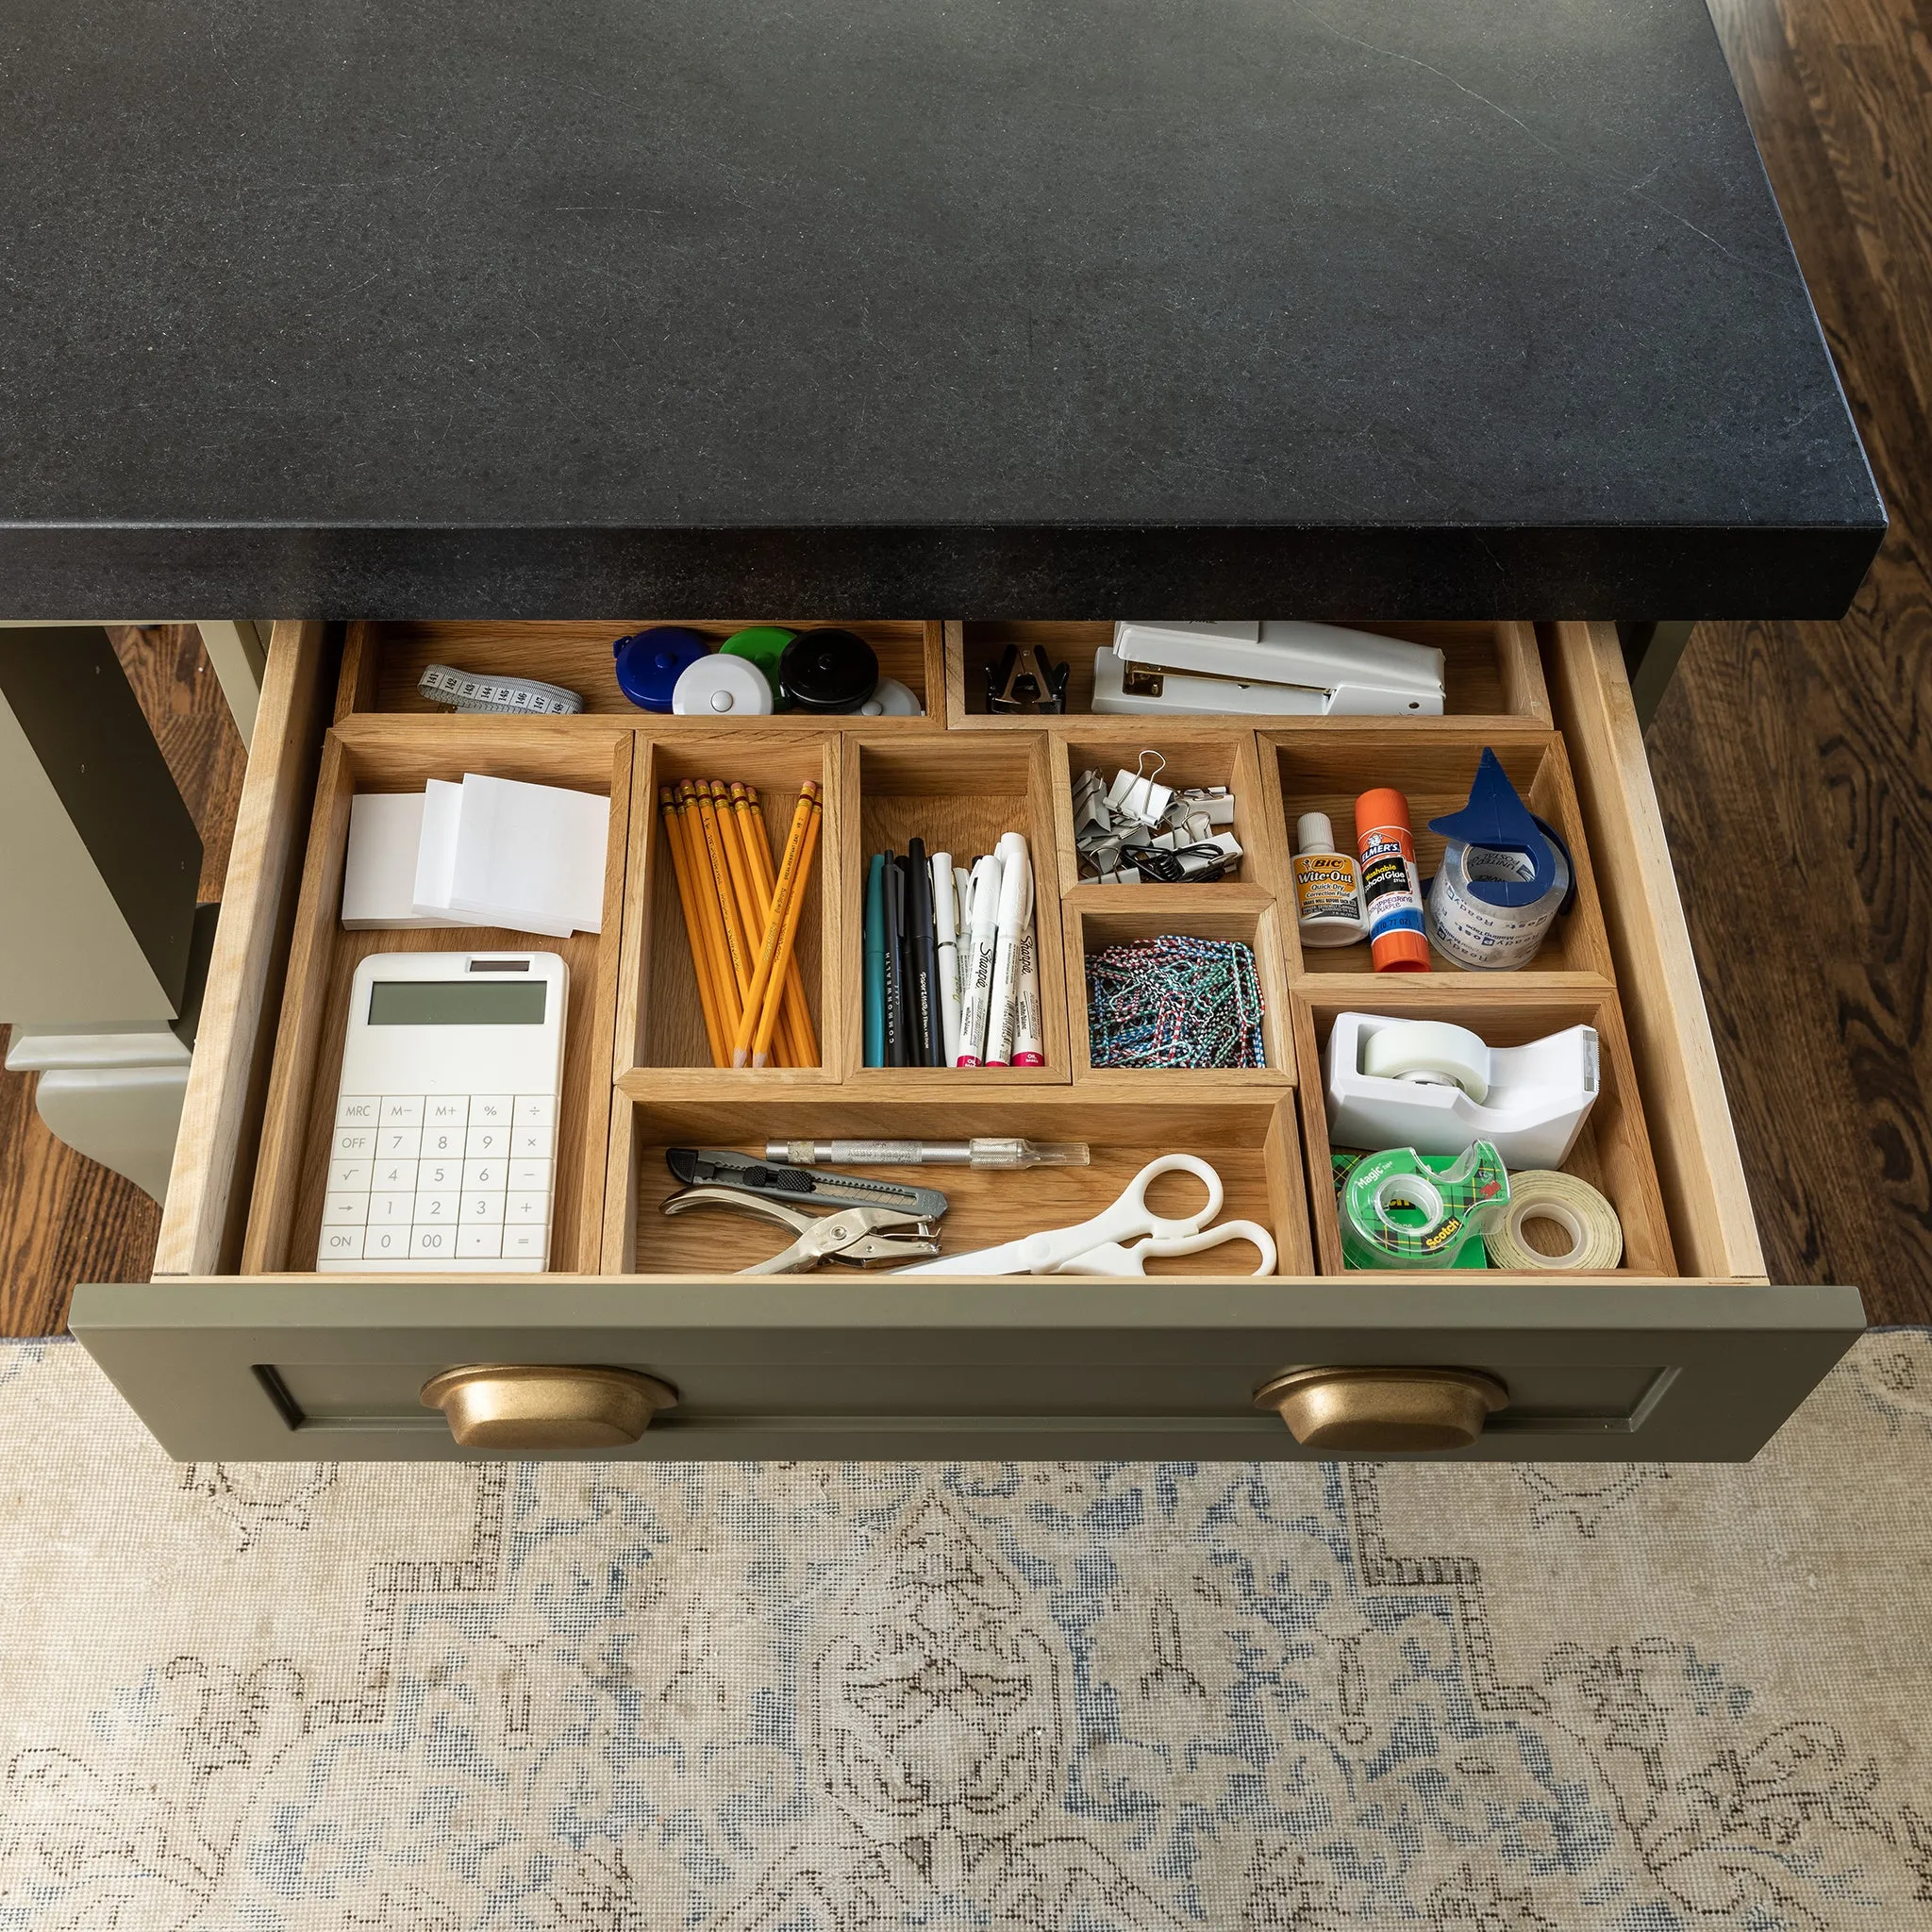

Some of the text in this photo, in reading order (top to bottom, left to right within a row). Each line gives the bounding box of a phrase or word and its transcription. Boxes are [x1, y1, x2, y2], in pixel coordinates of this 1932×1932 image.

[426, 673, 439, 684] 141
[445, 678, 457, 690] 142
[463, 684, 475, 695] 143
[481, 688, 492, 699] 144
[498, 690, 509, 701] 145
[516, 692, 526, 705] 146
[534, 697, 545, 709] 147
[552, 704, 564, 714] 148
[1362, 843, 1398, 861] ELMER'S
[976, 941, 992, 989] Sharpie
[1020, 935, 1032, 975] Sharpie
[885, 952, 894, 1043] COMMONWEALTH
[345, 1105, 371, 1118] MRC
[435, 1106, 457, 1116] M+
[484, 1106, 497, 1117] %
[341, 1137, 366, 1149] OFF
[392, 1136, 403, 1150] 7
[438, 1136, 448, 1150] 8
[482, 1136, 492, 1150] 9
[388, 1168, 398, 1181] 4
[434, 1168, 444, 1182] 5
[479, 1168, 489, 1182] 6
[1357, 1165, 1384, 1190] Magic
[1479, 1180, 1502, 1200] 3M
[388, 1201, 392, 1214] 1
[430, 1201, 441, 1215] 2
[476, 1201, 486, 1215] 3
[330, 1236, 352, 1247] ON
[381, 1235, 391, 1248] 0
[422, 1234, 442, 1248] 00
[1425, 1219, 1461, 1249] Scotch
